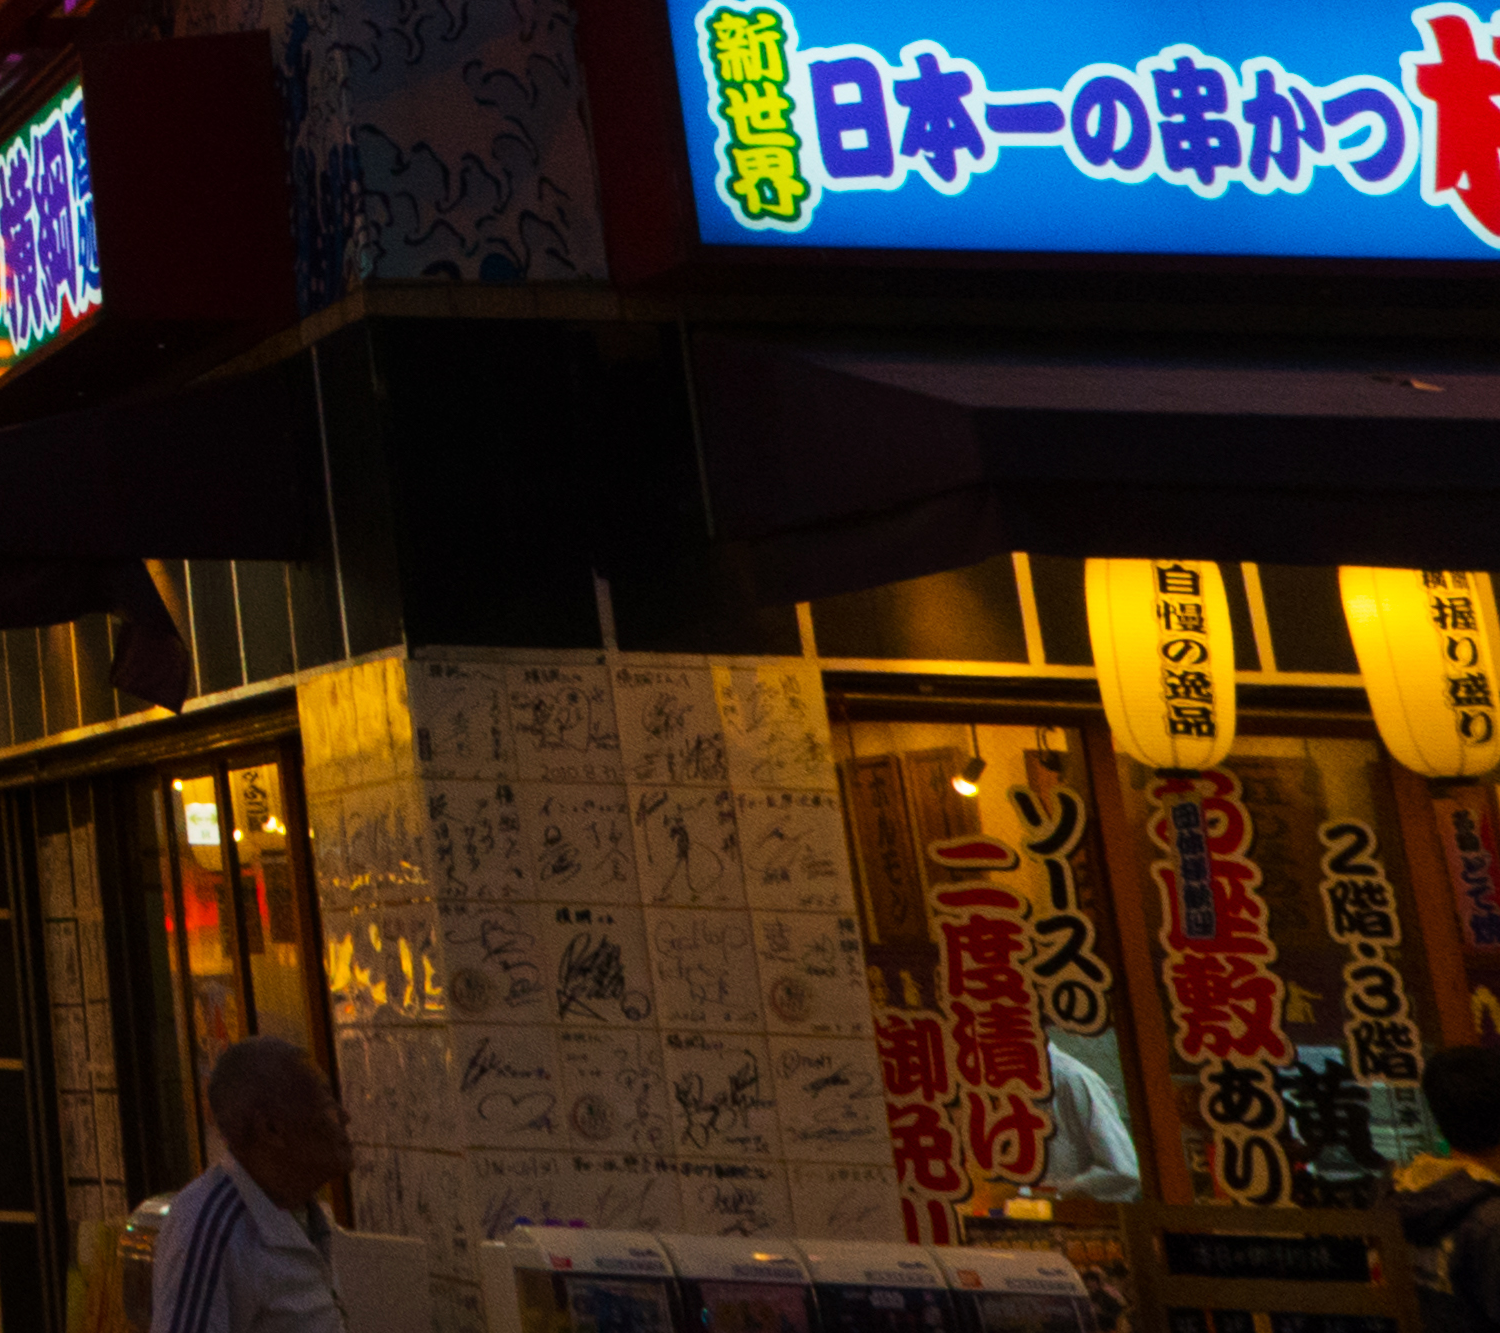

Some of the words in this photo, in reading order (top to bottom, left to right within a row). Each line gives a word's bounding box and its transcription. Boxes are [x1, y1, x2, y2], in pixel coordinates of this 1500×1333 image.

[710, 6, 807, 225] 新世界
[809, 52, 1408, 188] 日本一の串かつ
[1155, 562, 1217, 740] 自慢の逸品
[1430, 593, 1498, 746] 握り盛り
[1011, 791, 1106, 1024] ソースの
[934, 841, 1045, 1175] 二度漬け
